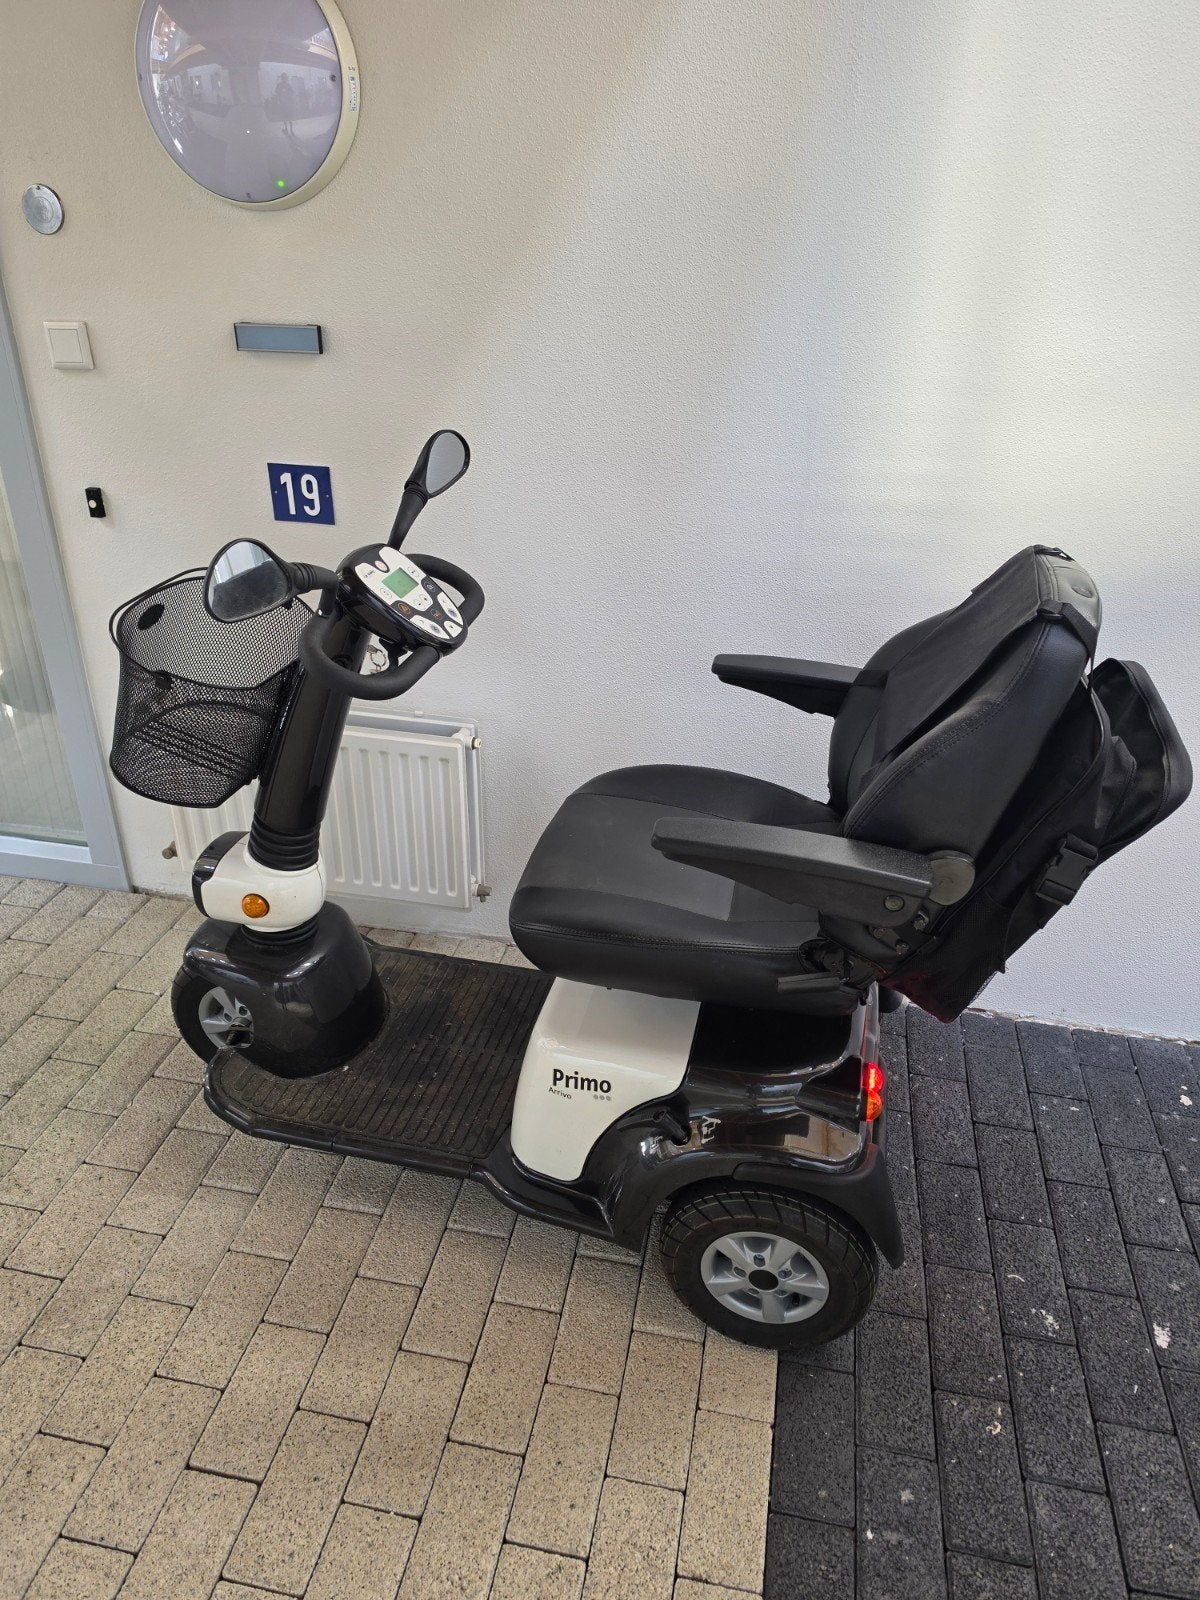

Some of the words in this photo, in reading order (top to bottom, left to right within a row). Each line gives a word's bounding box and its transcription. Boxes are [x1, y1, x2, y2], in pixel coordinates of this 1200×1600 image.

[280, 472, 321, 516] 19
[548, 1086, 572, 1100] Arrivo
[553, 1068, 612, 1094] Primo
